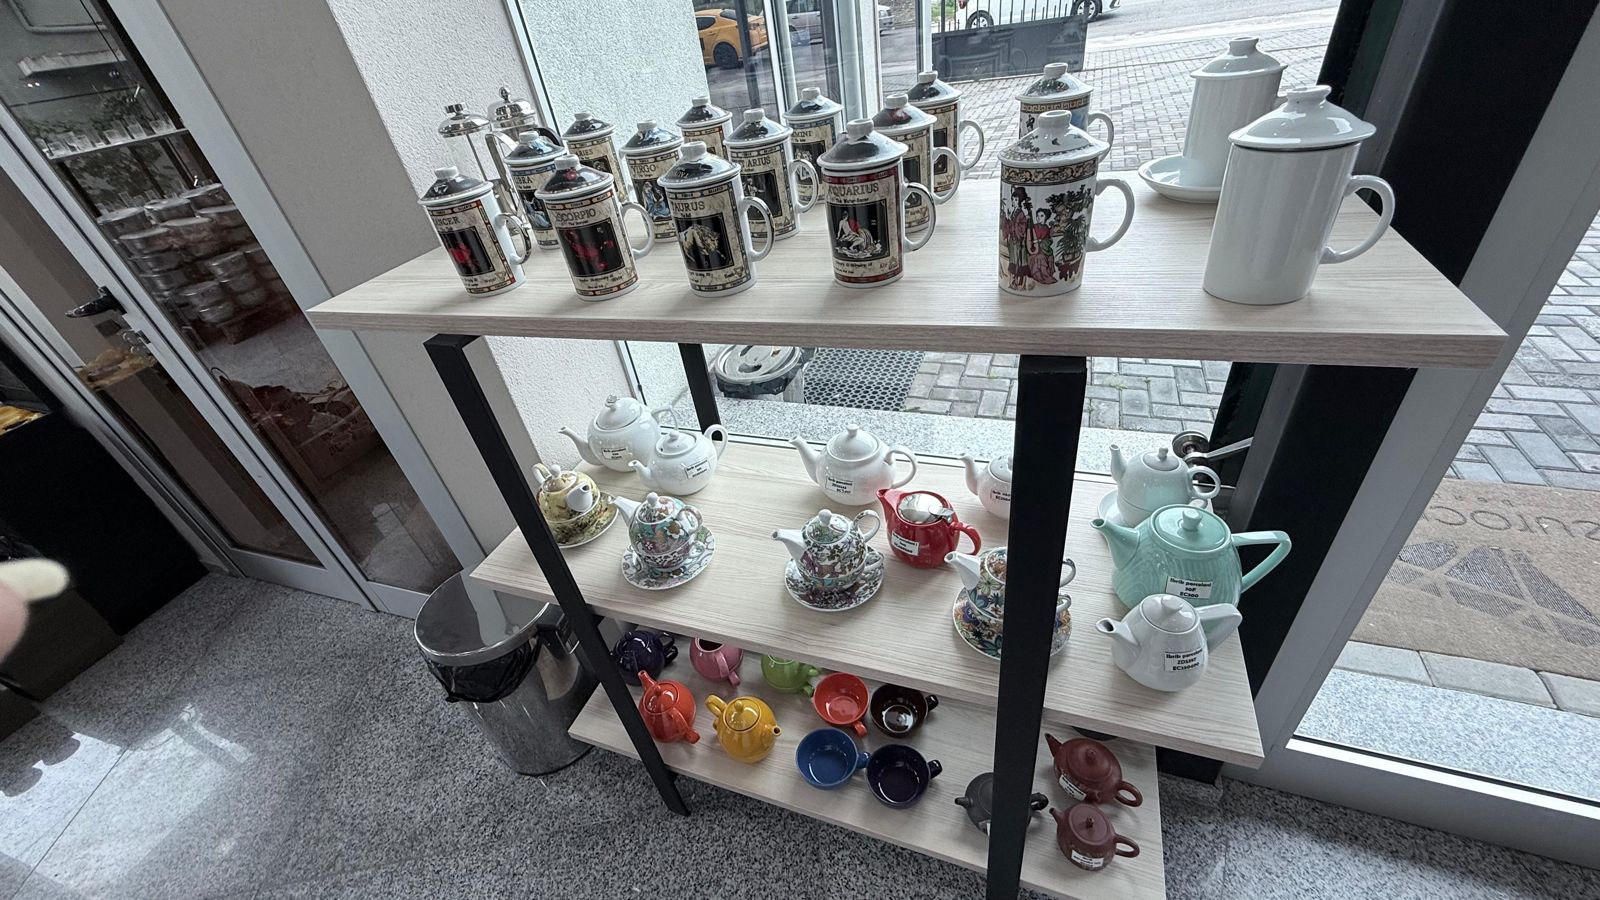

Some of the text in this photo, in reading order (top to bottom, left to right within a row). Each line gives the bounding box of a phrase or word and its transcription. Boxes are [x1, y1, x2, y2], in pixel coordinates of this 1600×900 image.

[631, 163, 656, 173] VIRGO
[828, 183, 880, 197] AQUARIUS
[556, 208, 597, 222] SCORPIO
